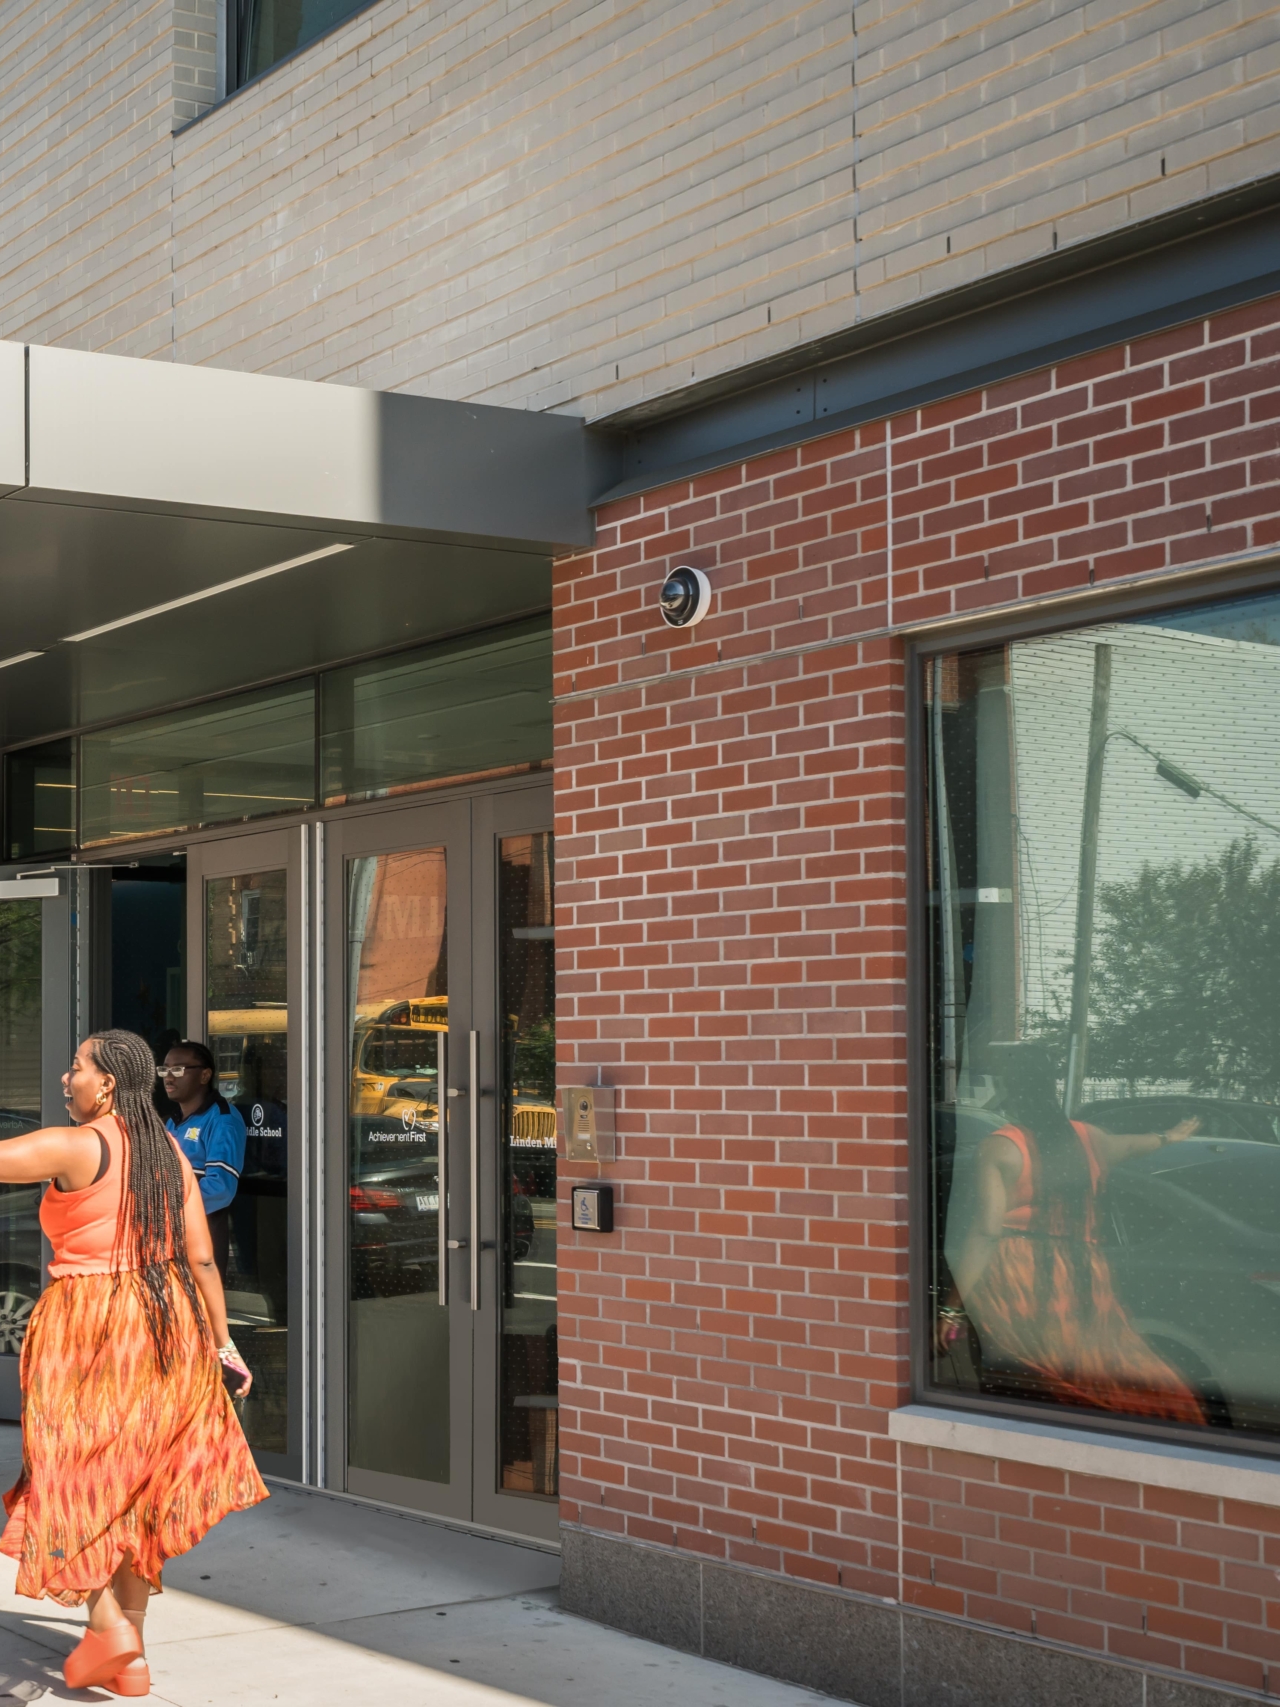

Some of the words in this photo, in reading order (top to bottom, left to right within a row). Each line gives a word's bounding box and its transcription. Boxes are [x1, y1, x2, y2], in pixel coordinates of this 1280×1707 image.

[260, 1127, 282, 1137] School
[368, 1131, 410, 1142] Achievement
[410, 1131, 427, 1142] First
[510, 1135, 542, 1148] Linden
